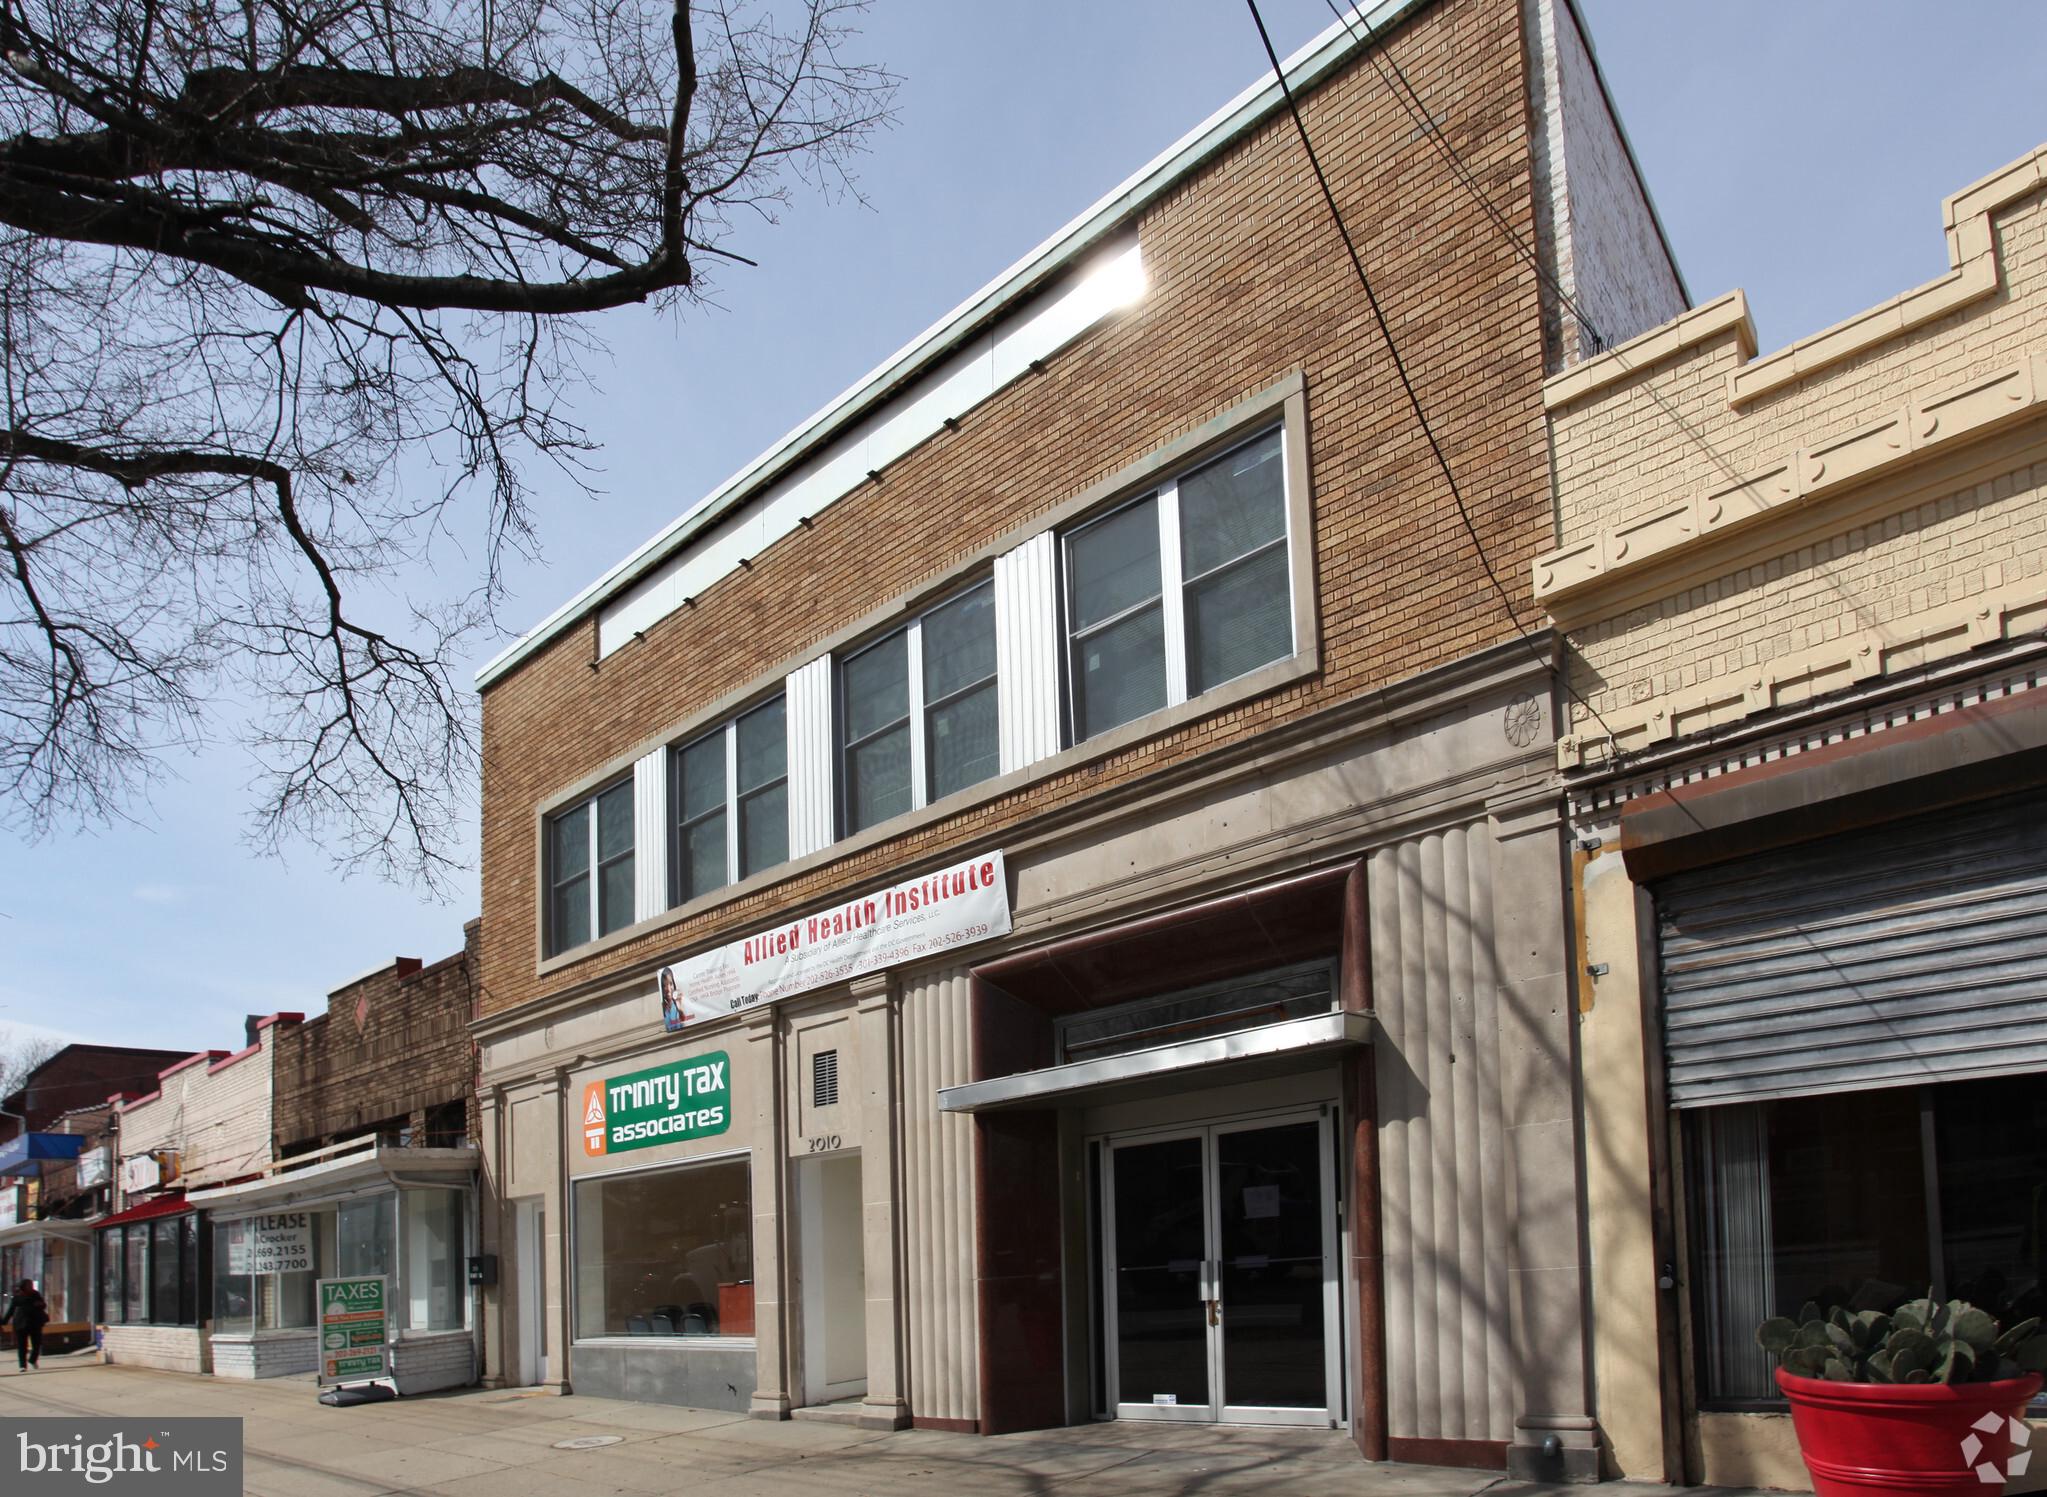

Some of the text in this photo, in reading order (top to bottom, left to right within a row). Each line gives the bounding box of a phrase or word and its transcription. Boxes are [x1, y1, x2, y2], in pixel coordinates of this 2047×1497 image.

[744, 861, 995, 966] Allied Health Institute
[730, 996, 741, 1009] Call
[912, 943, 926, 954] Fax
[928, 923, 988, 950] 202-526-3939
[808, 1134, 842, 1153] 2010
[260, 1214, 307, 1231] LEASE
[325, 1282, 379, 1300] TAXES
